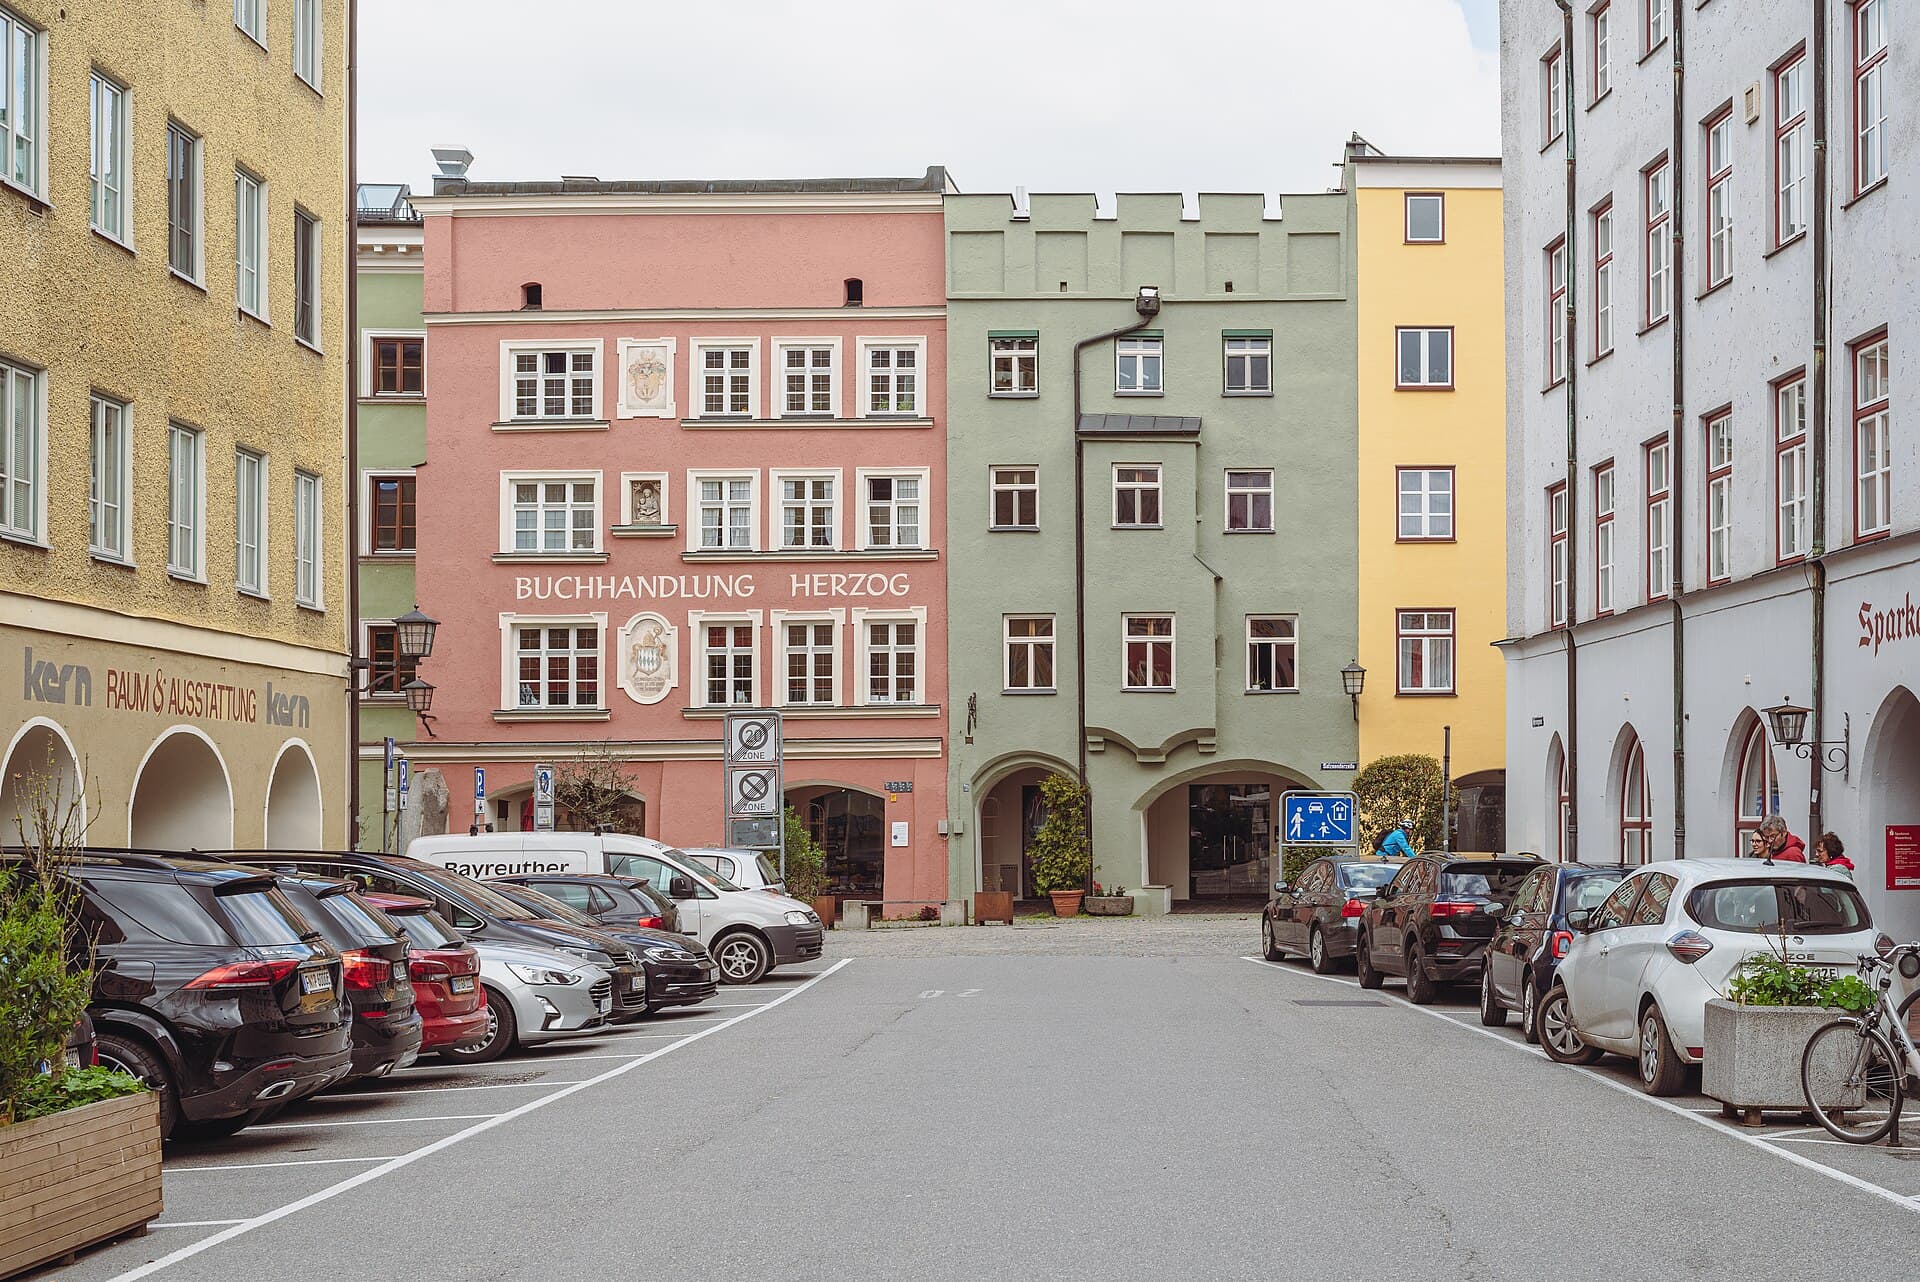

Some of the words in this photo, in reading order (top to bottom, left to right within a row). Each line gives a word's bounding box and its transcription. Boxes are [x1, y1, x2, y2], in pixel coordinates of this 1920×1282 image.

[515, 574, 756, 600] BUCHHANDLUNG
[790, 573, 910, 597] HERZOG
[106, 669, 150, 713] RAUM
[152, 668, 168, 717] &
[168, 680, 257, 724] AUSSTATTUNG
[745, 729, 763, 743] 20
[742, 751, 766, 760] ZONE
[743, 802, 767, 812] ZONE
[444, 861, 570, 879] Bayreuther
